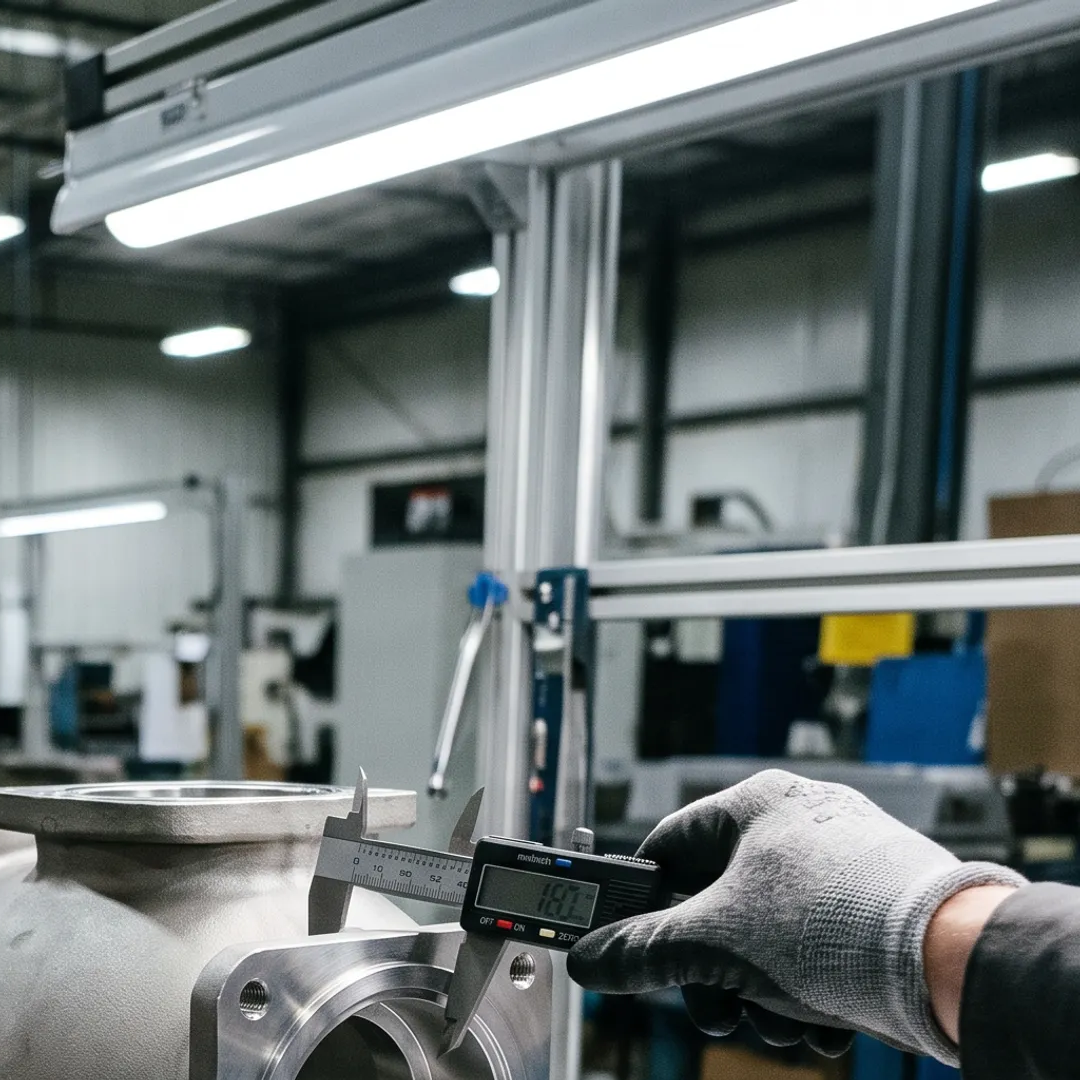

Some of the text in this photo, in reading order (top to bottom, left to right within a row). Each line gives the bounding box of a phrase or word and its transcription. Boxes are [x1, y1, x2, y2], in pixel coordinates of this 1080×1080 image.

[353, 857, 360, 865] 0
[373, 864, 384, 873] 10
[514, 924, 525, 932] ON
